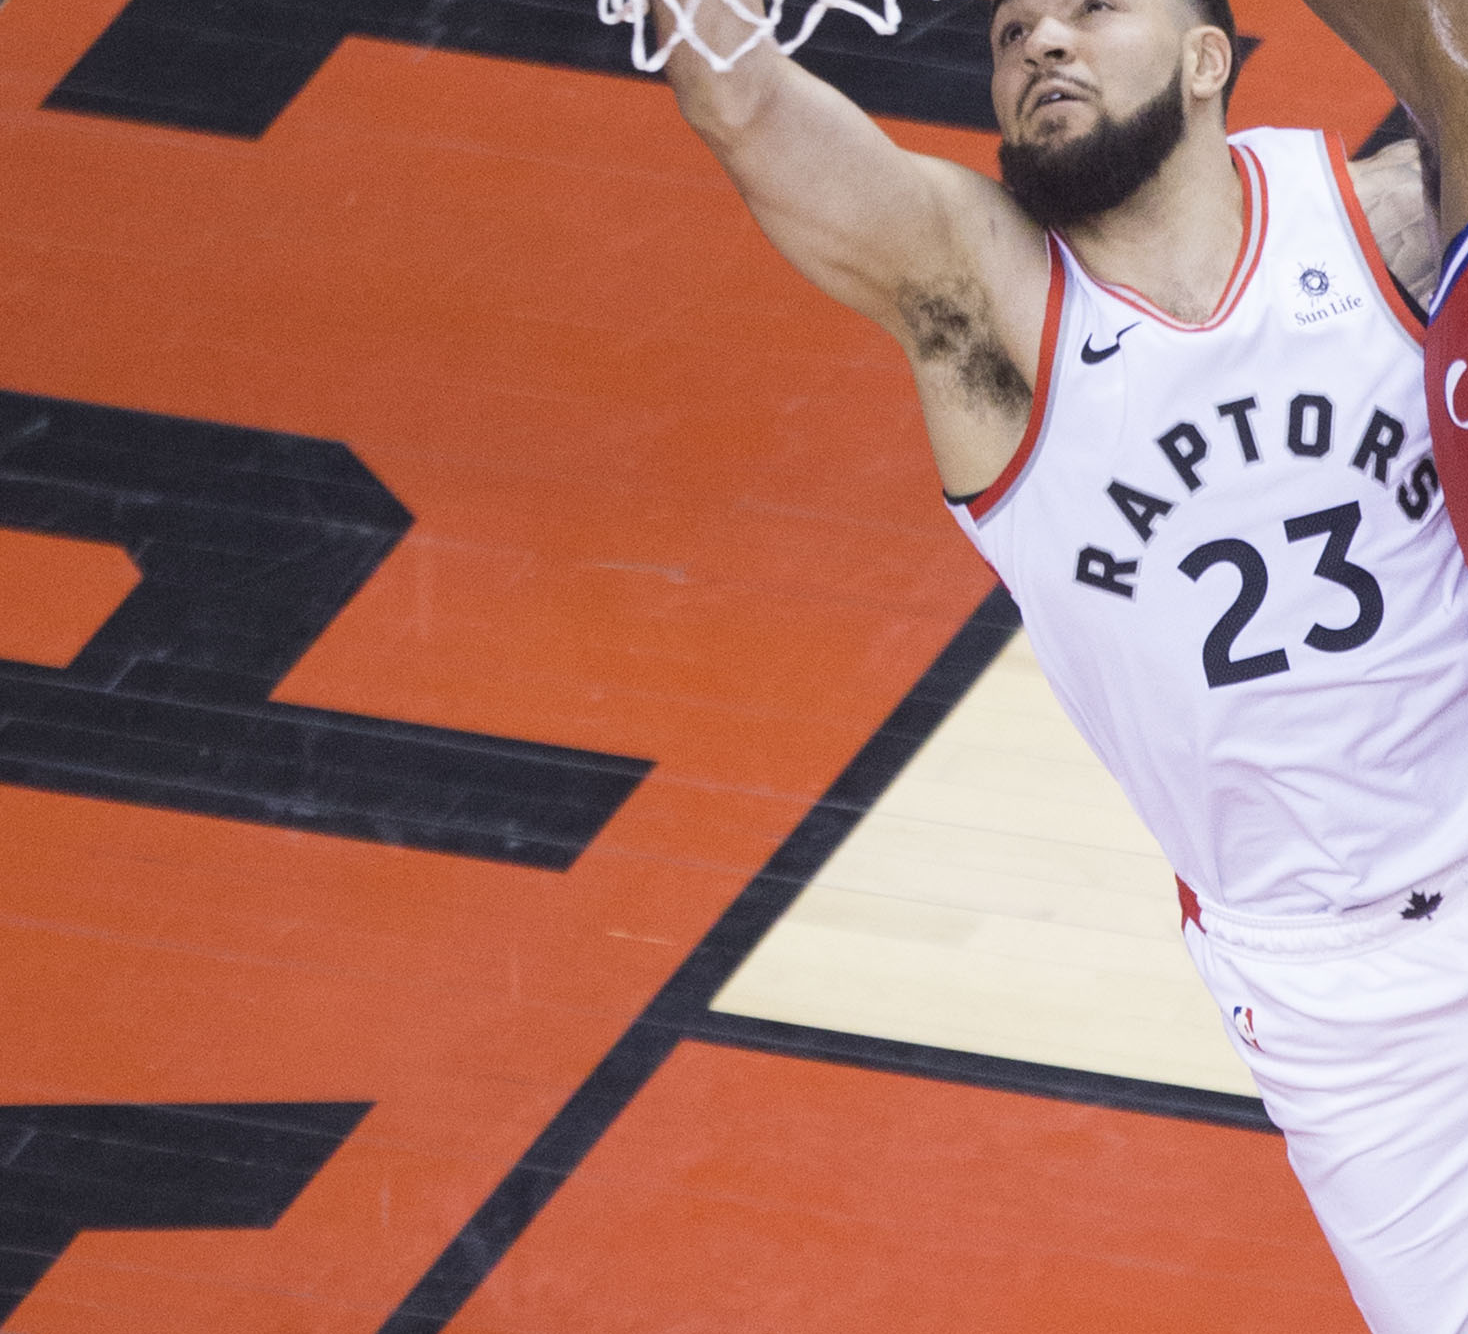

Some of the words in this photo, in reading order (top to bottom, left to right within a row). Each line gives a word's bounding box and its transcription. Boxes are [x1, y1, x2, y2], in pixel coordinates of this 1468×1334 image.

[1294, 309, 1329, 327] Sun
[1330, 294, 1363, 316] Life
[1073, 390, 1442, 603] RAPTORS
[1176, 499, 1385, 690] 23
